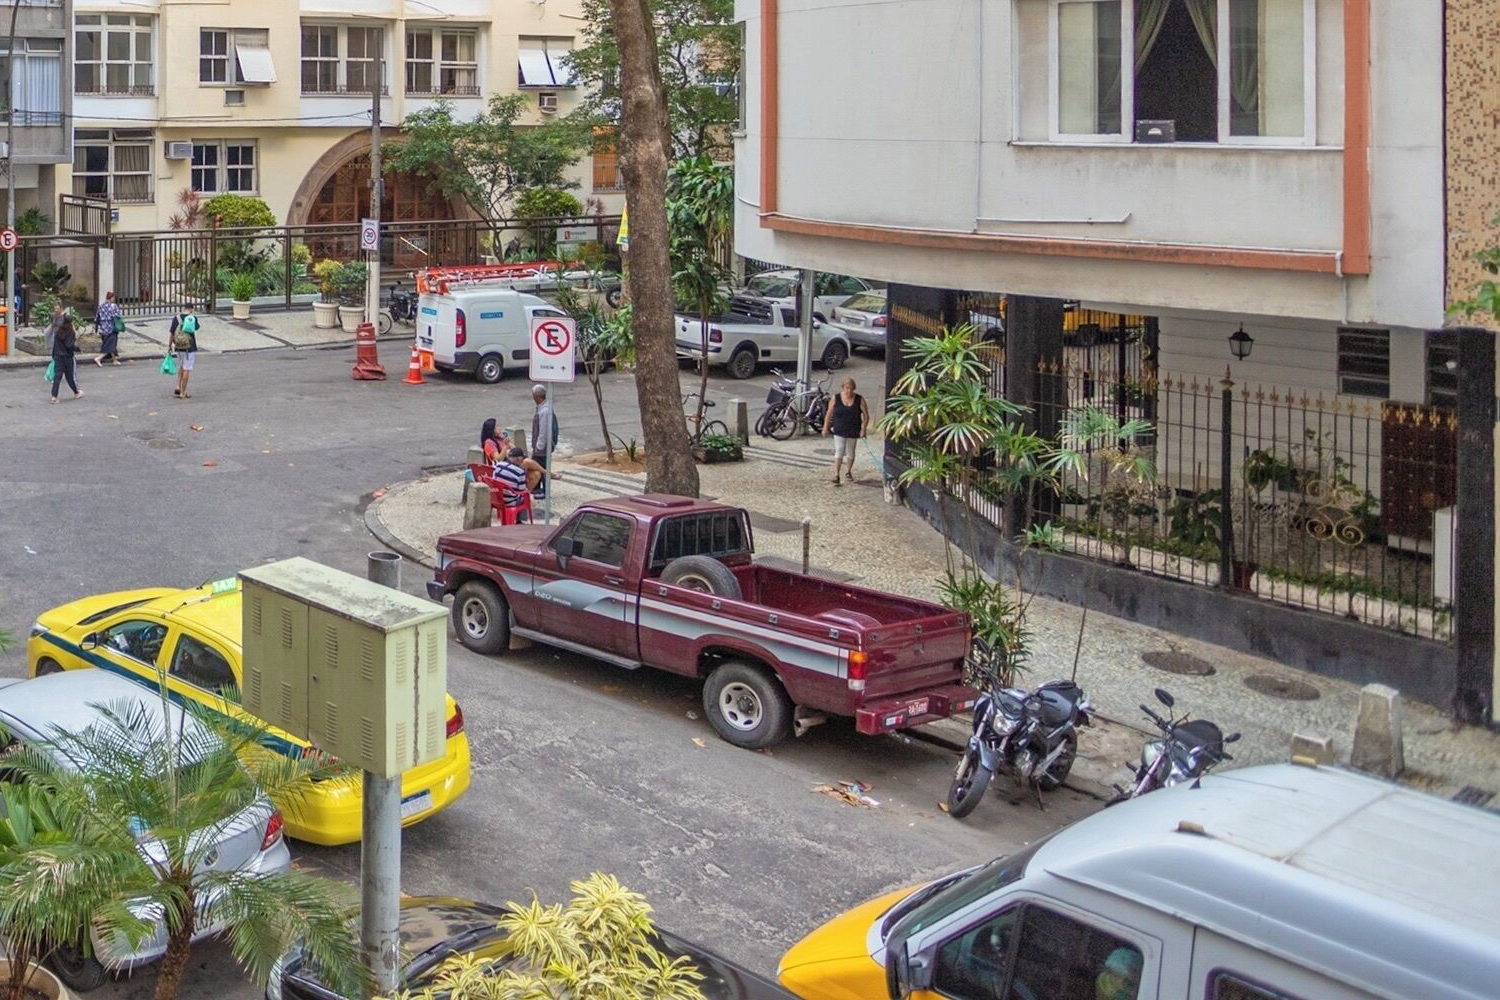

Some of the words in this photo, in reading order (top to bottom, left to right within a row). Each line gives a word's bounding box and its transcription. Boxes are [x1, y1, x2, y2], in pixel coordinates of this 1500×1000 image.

[546, 328, 559, 347] E
[212, 577, 236, 593] TAXI
[535, 590, 551, 600] D20
